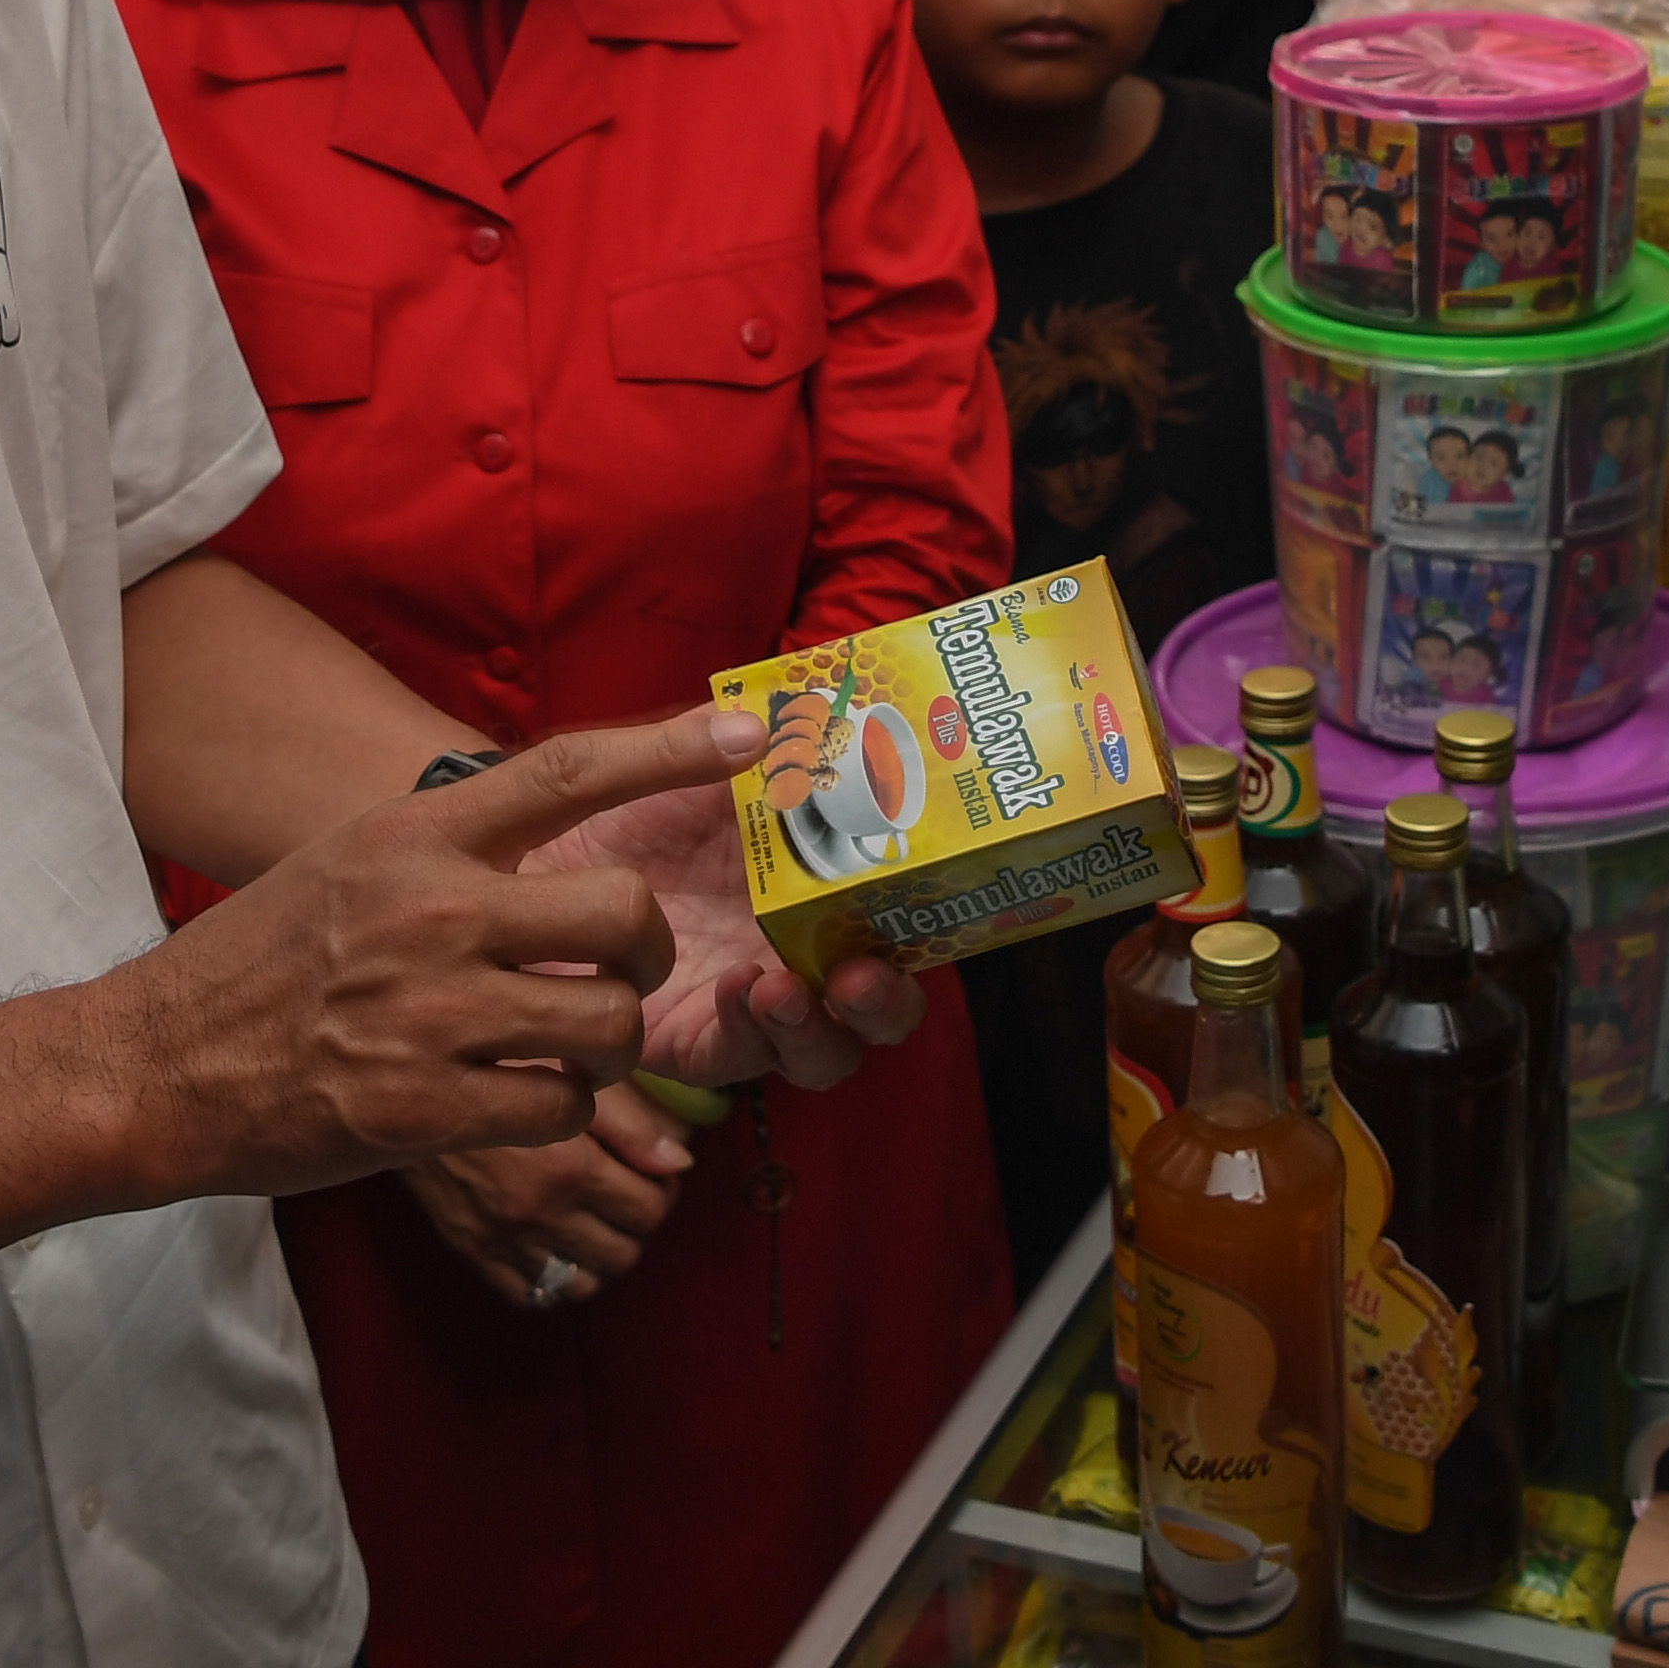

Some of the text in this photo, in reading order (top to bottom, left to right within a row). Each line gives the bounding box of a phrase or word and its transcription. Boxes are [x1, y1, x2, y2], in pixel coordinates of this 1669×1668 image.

[1000, 591, 1031, 644] Bisma
[929, 599, 1065, 820] Temulawak
[933, 710, 959, 746] Plus
[1096, 703, 1113, 730] HOT
[1108, 746, 1126, 782] COOL
[953, 766, 993, 831] instan
[873, 825, 1153, 945] Temulawak
[1087, 860, 1161, 899] instan
[1013, 903, 1054, 926] Plus
[1161, 1431, 1272, 1482] Kencur
